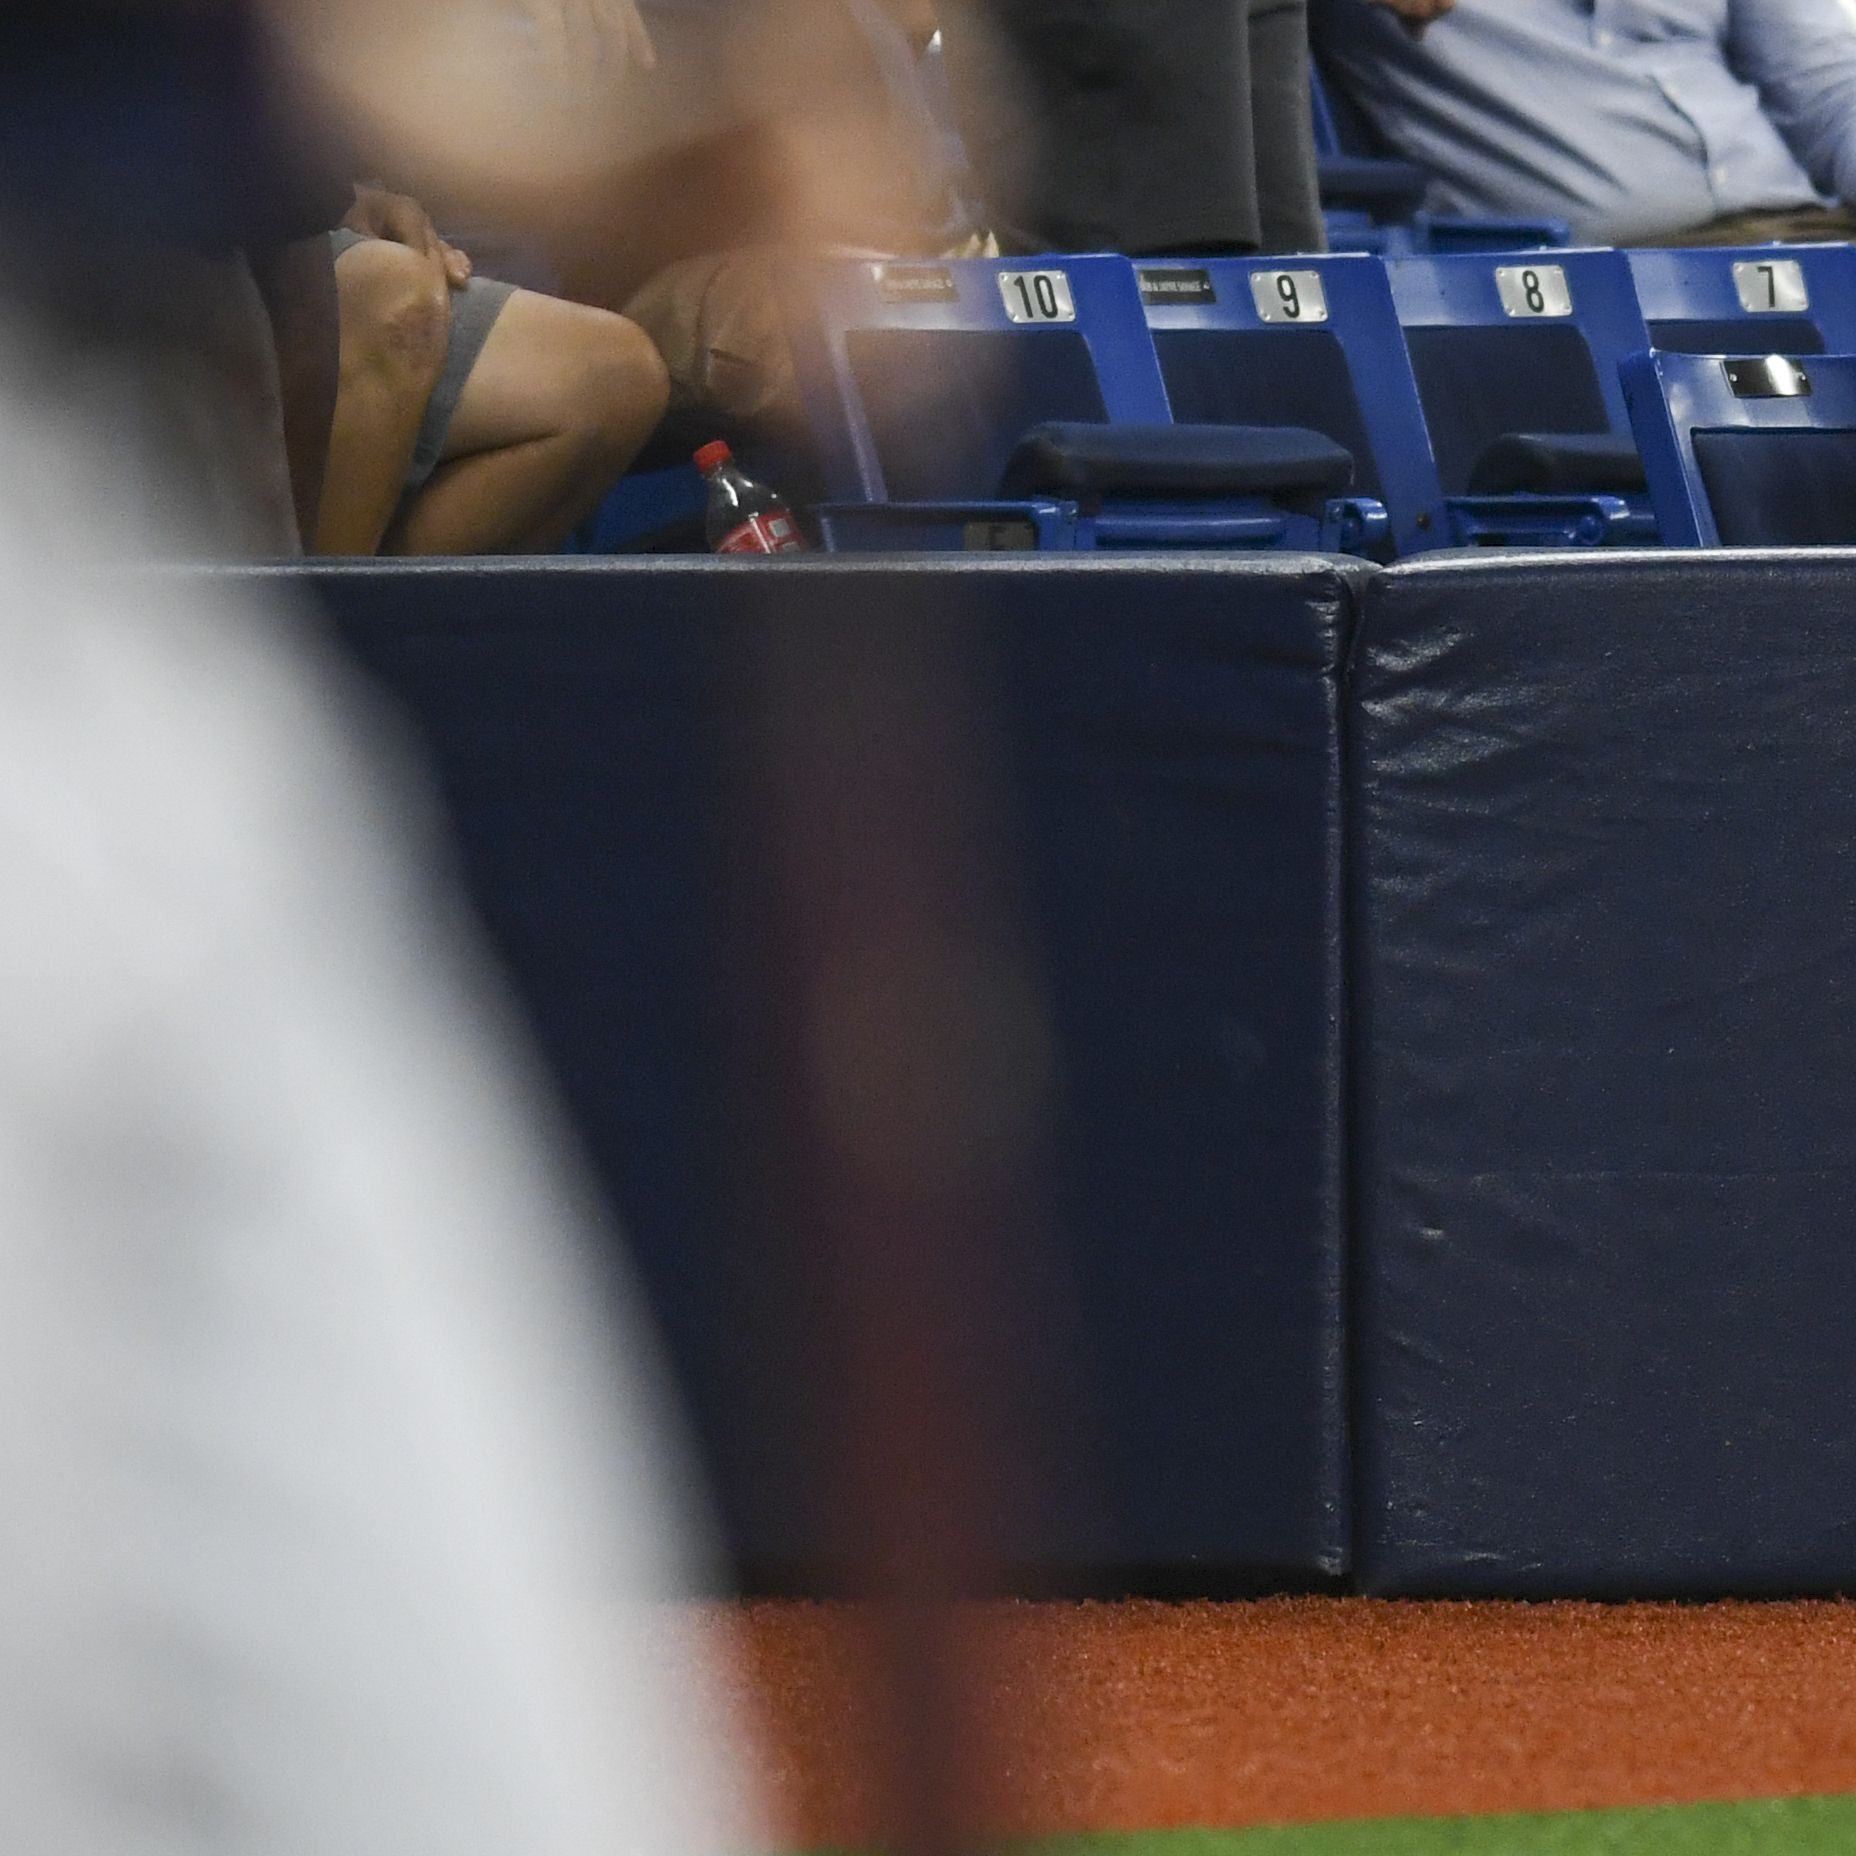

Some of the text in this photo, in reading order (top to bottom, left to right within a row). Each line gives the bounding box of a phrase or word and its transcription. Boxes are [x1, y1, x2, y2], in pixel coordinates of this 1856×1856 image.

[1014, 275, 1058, 319] 10
[1276, 274, 1300, 319] 9
[1523, 270, 1545, 313] 8
[1756, 265, 1776, 310] 7
